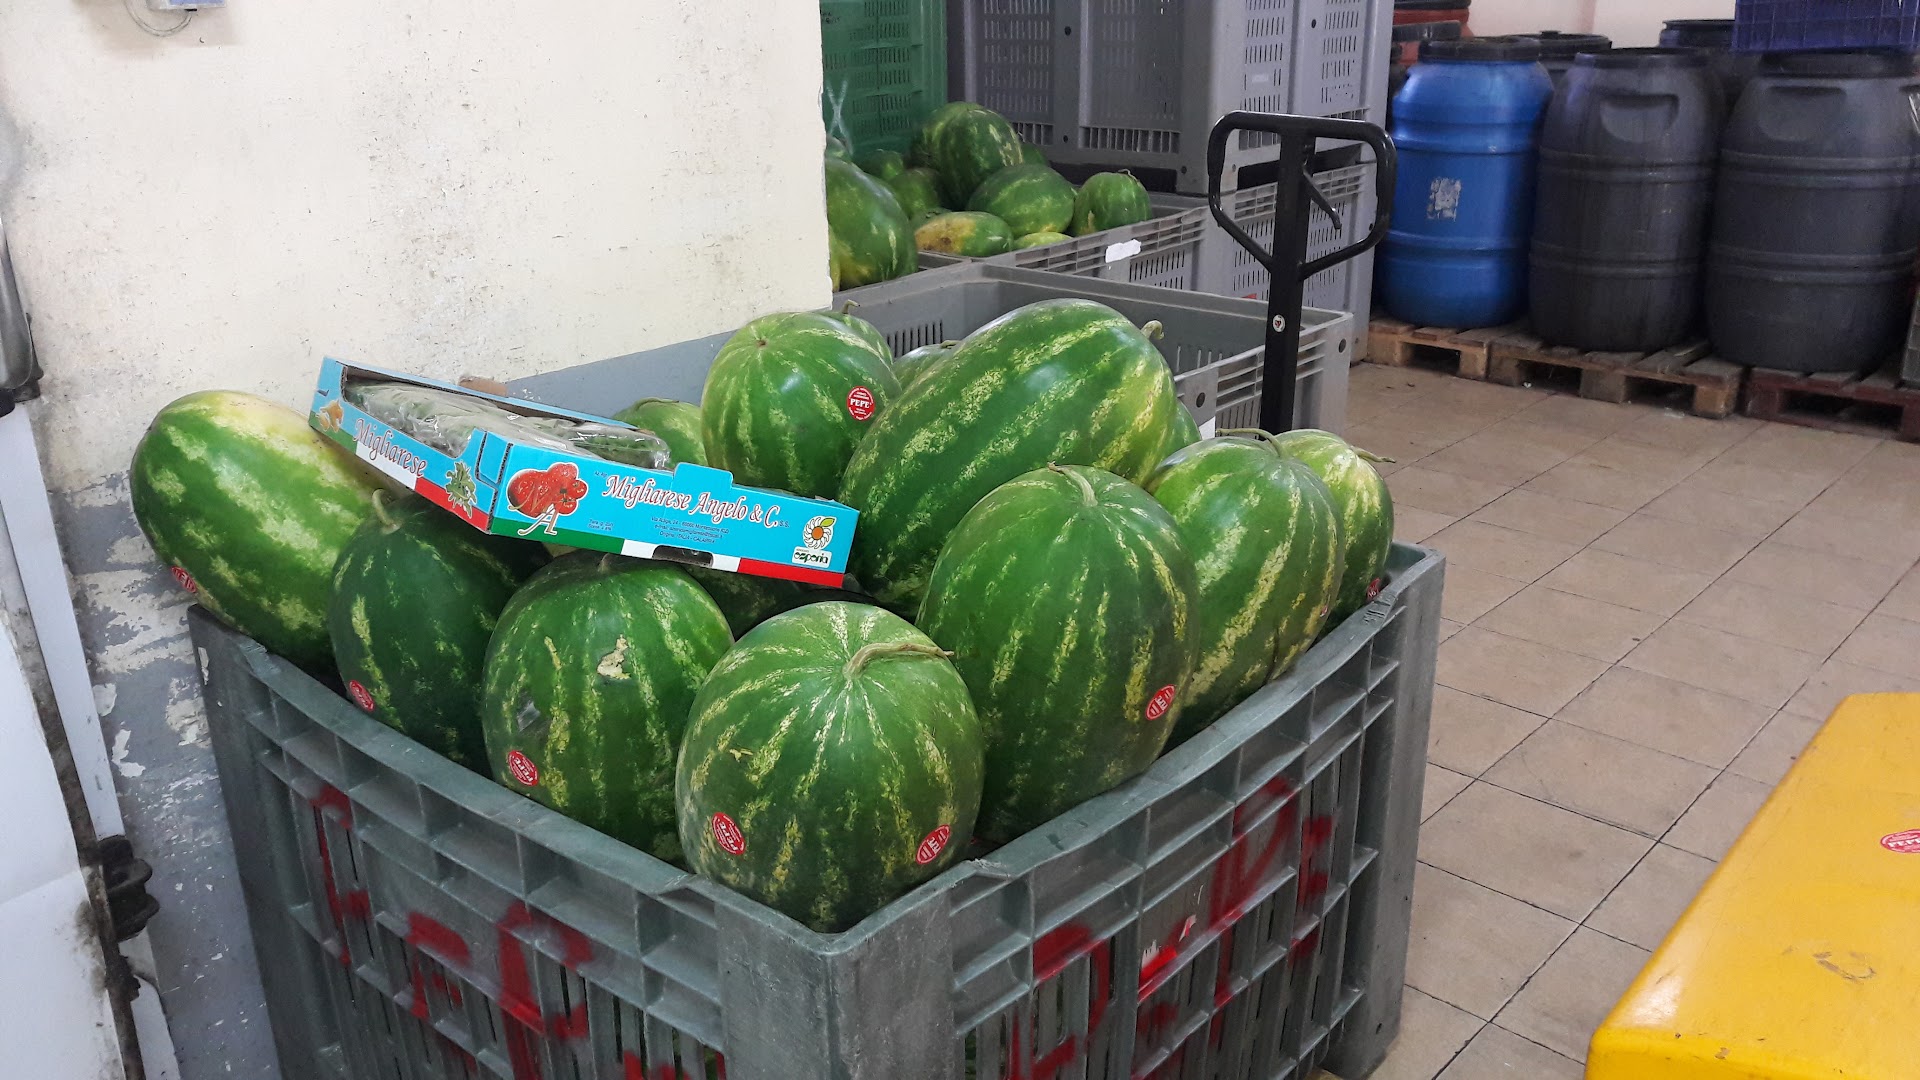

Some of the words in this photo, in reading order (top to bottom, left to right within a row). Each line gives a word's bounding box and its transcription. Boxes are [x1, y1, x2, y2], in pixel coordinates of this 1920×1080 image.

[850, 398, 870, 409] PEPE
[353, 417, 427, 478] Migliarese
[602, 475, 692, 509] Migliarese
[689, 491, 748, 524] Angelo
[749, 503, 763, 522] &
[764, 504, 780, 529] C.
[794, 552, 829, 564] esperia
[513, 757, 534, 782] PEPE
[717, 820, 739, 851] PEPE
